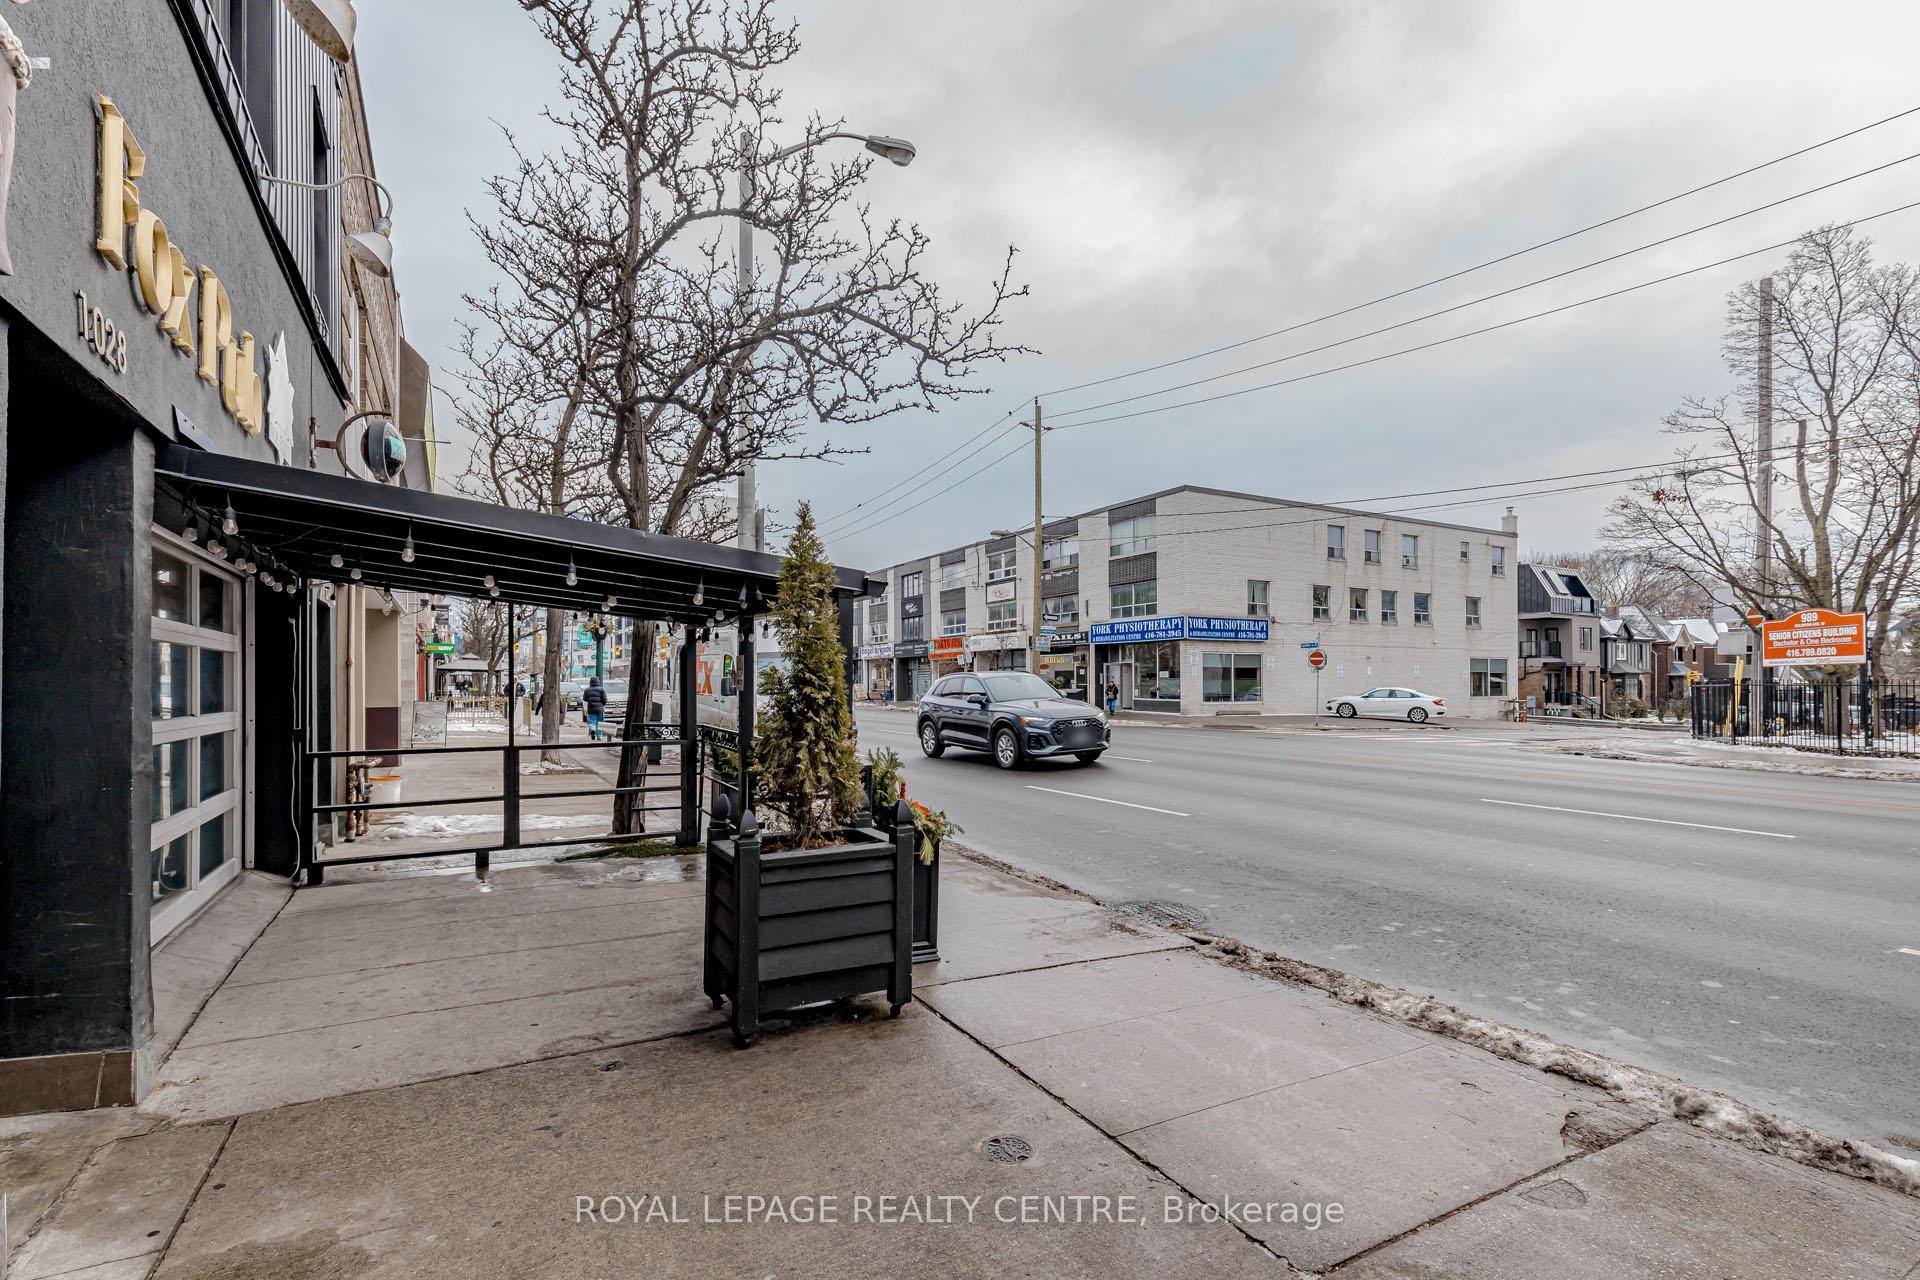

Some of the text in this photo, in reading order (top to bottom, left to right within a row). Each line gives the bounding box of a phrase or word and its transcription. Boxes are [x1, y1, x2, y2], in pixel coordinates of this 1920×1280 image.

[78, 289, 127, 375] 1028
[1801, 612, 1818, 622] 989
[1092, 617, 1183, 635] YORK PHYSIOTHERAPY
[1189, 618, 1268, 631] YORK PHYSIOTHERAPY
[1144, 629, 1182, 639] 416-781-3945
[1768, 626, 1858, 640] SENIOR CITIZENS BUILDING
[1773, 639, 1799, 647] Bachelor
[1820, 636, 1852, 644] Bedroom
[1786, 647, 1837, 657] 416.789.0820
